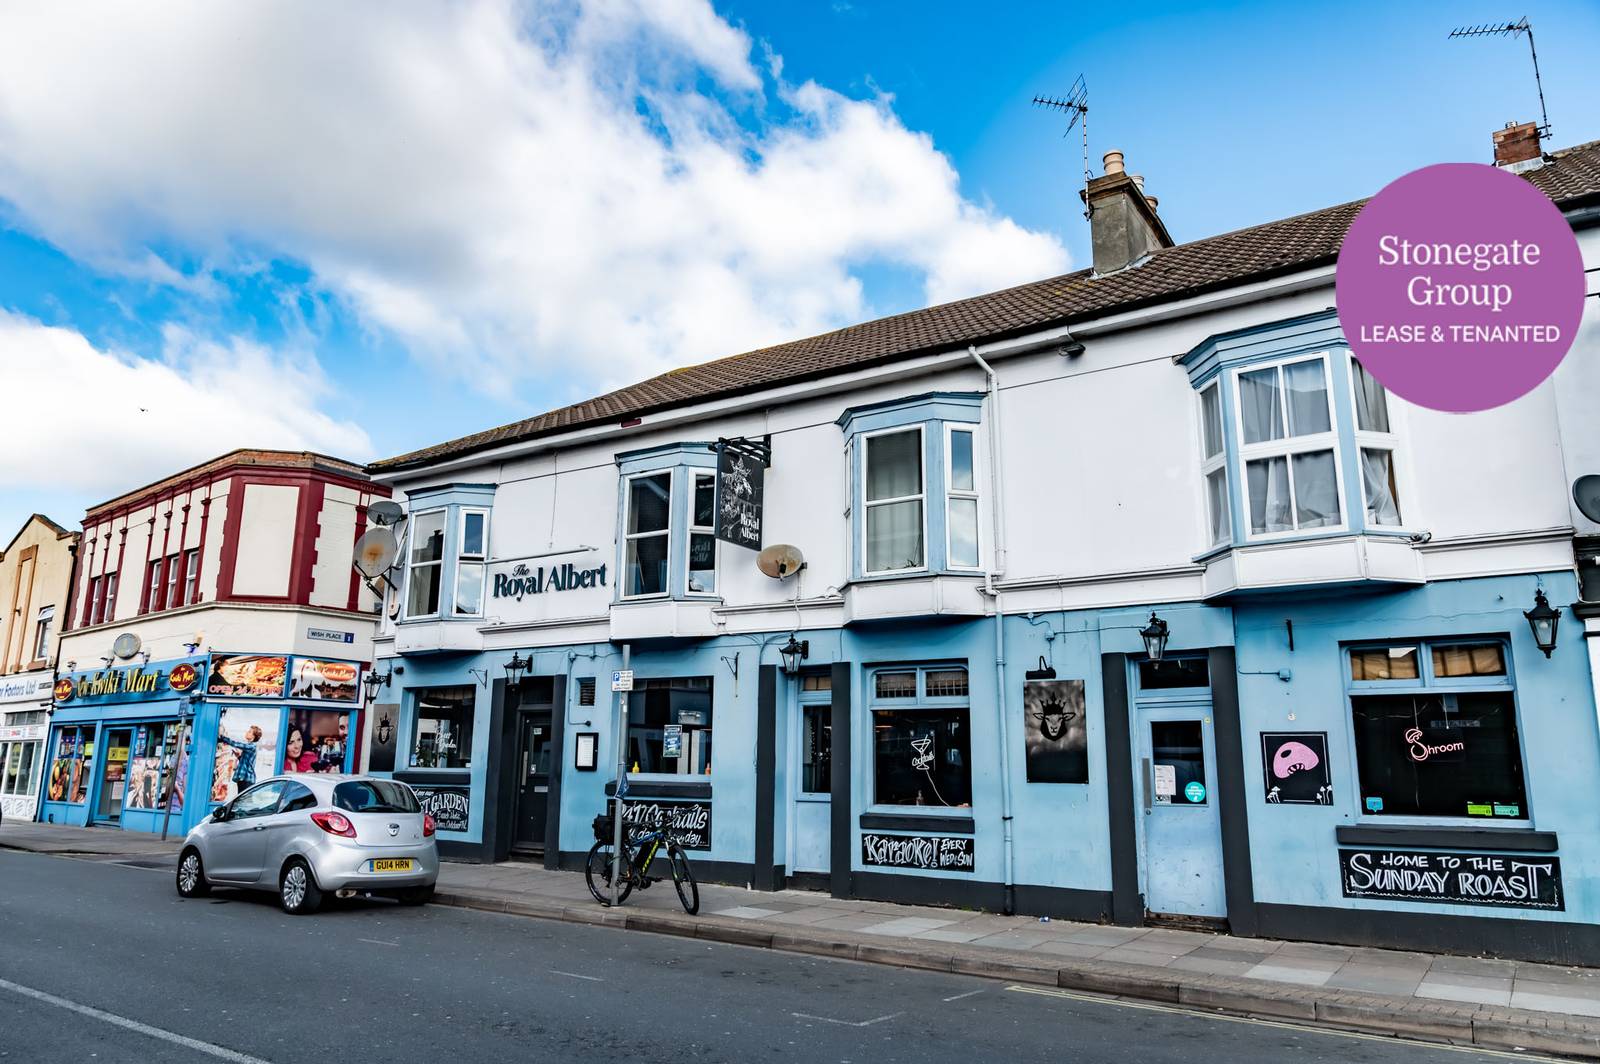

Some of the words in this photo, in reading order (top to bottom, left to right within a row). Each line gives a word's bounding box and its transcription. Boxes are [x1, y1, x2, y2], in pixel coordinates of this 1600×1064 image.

[740, 512, 760, 530] Royal
[741, 526, 759, 542] Albert
[512, 564, 530, 577] The
[493, 567, 544, 602] Royal
[545, 563, 607, 592] Albert
[123, 668, 159, 693] Mart
[209, 685, 233, 694] OPEN
[1405, 728, 1465, 761] Shroom
[430, 793, 469, 817] GARDEN
[863, 835, 940, 868] Karaoke!
[940, 838, 968, 852] EVERY
[376, 861, 393, 870] GU14
[395, 860, 410, 869] HRN
[1380, 853, 1429, 868] HOME
[1436, 856, 1461, 869] TO
[1466, 857, 1506, 871] THE
[1350, 853, 1450, 893] SUNDAY
[1458, 861, 1553, 899] ROAST
